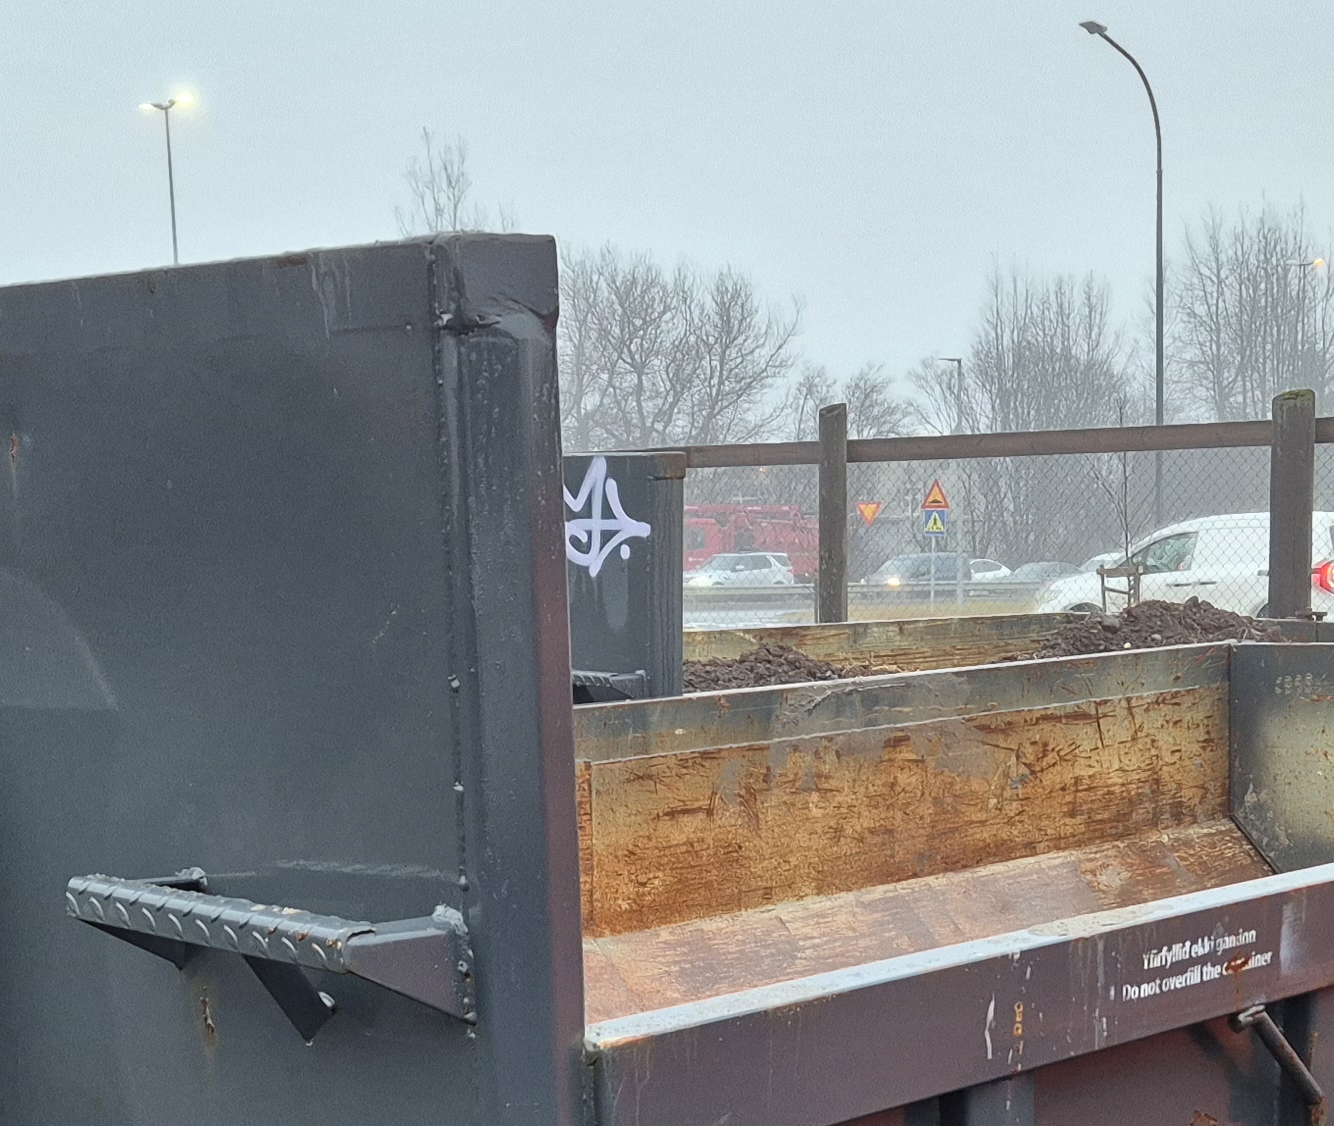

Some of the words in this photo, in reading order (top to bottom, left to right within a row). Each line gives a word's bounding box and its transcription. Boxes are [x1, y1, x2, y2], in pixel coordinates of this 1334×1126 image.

[1122, 983, 1139, 1002] Do
[1140, 978, 1161, 998] not
[1162, 964, 1201, 992] overfill
[1203, 961, 1221, 982] the
[1222, 951, 1273, 976] ciner
